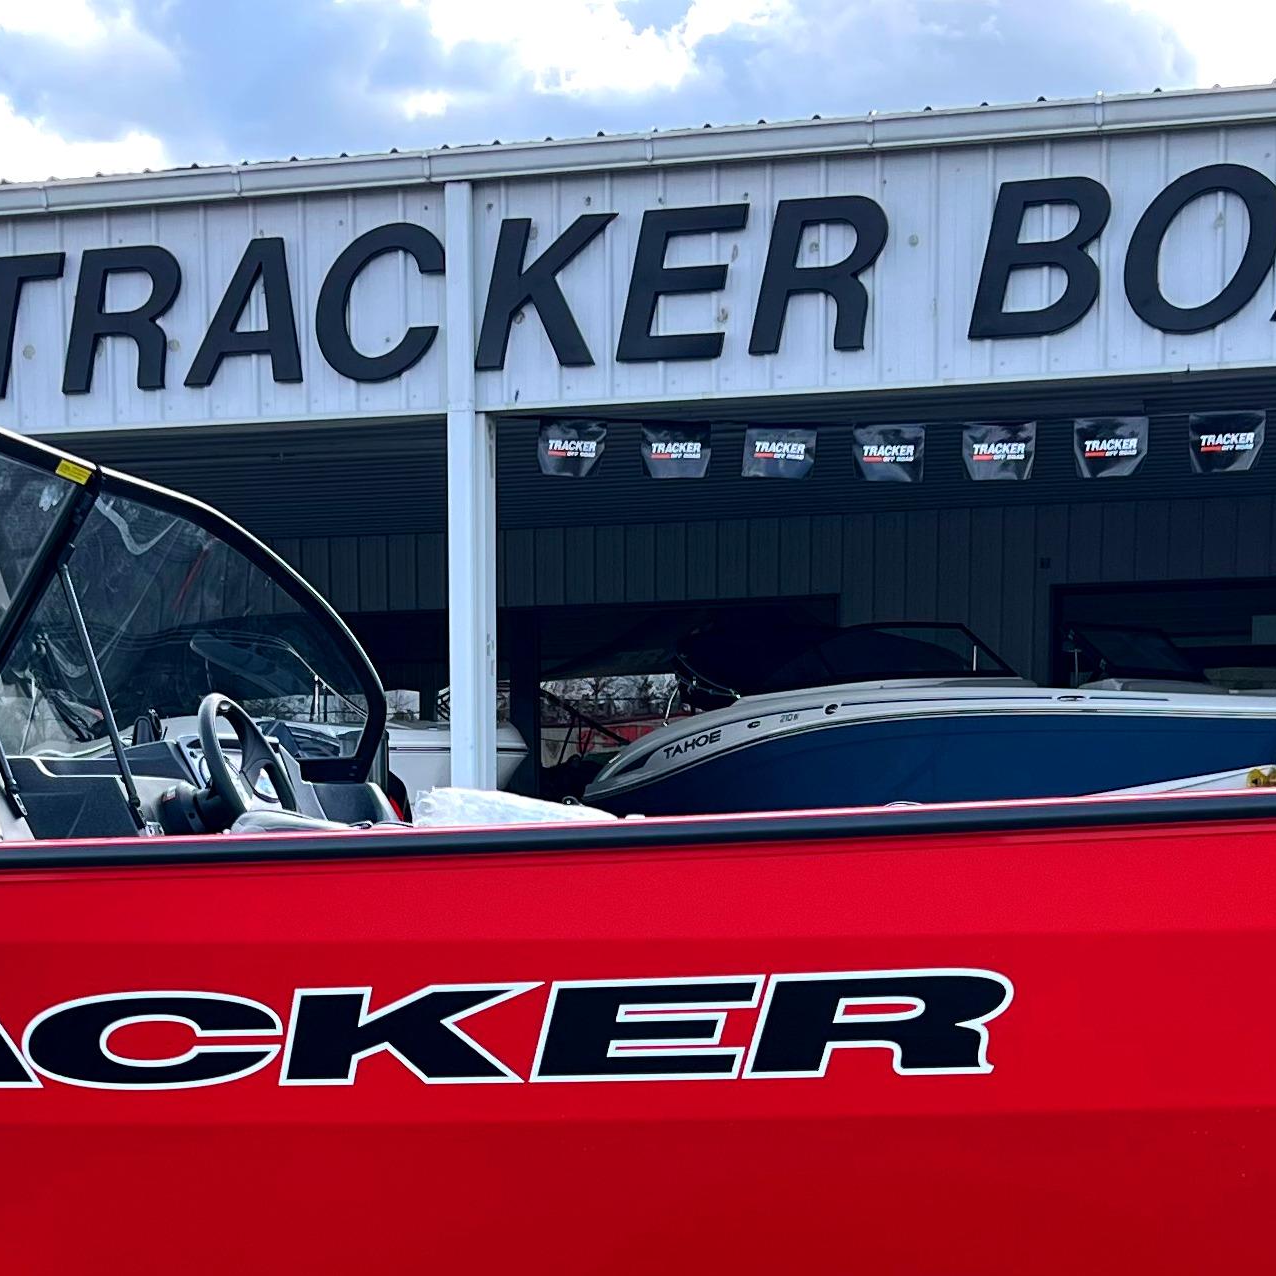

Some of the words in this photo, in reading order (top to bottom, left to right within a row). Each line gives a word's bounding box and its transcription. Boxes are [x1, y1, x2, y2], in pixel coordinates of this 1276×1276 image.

[548, 440, 597, 451] TRACKER
[1085, 438, 1138, 451] TRACKER
[1200, 433, 1254, 446] TRACKER
[651, 443, 701, 453] TRACKER
[755, 441, 805, 454] TRACKER
[863, 445, 914, 456] TRACKER
[973, 443, 1025, 455] TRACKER
[663, 729, 722, 759] TAHOE
